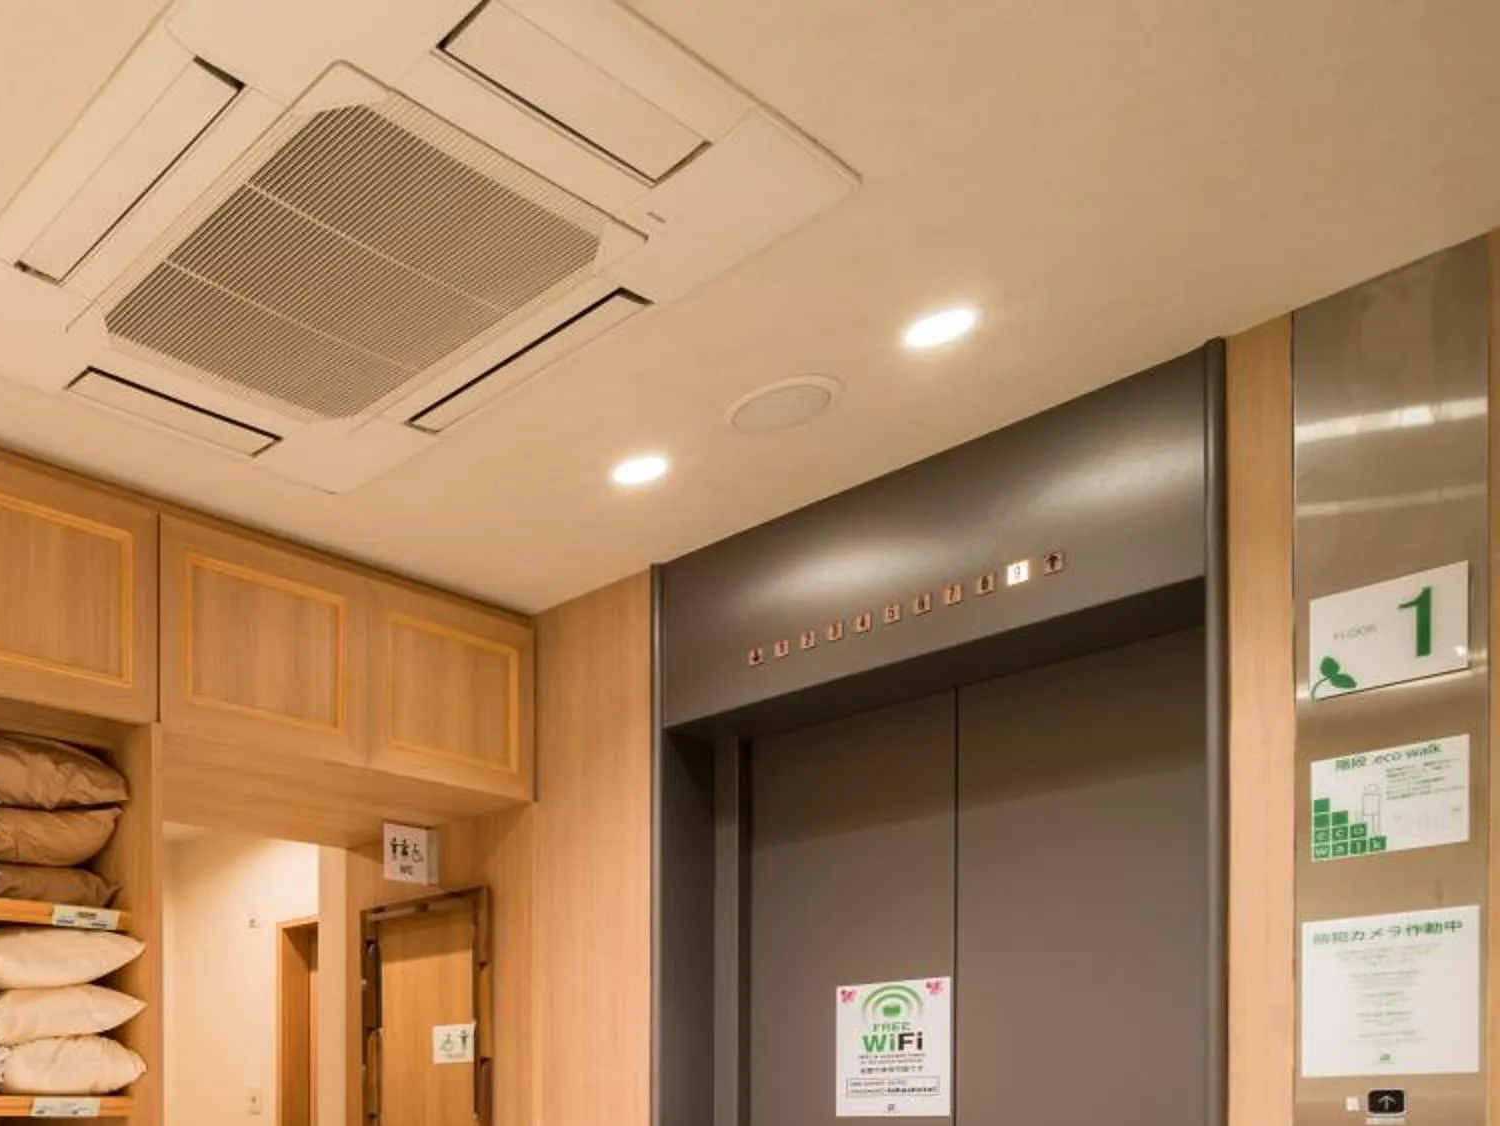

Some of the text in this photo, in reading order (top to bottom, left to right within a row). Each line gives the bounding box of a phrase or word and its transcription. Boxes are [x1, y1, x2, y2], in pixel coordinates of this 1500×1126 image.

[1398, 585, 1433, 657] 1
[1313, 920, 1464, 946] 防犯カメラ作動中
[862, 1031, 924, 1053] WiFi
